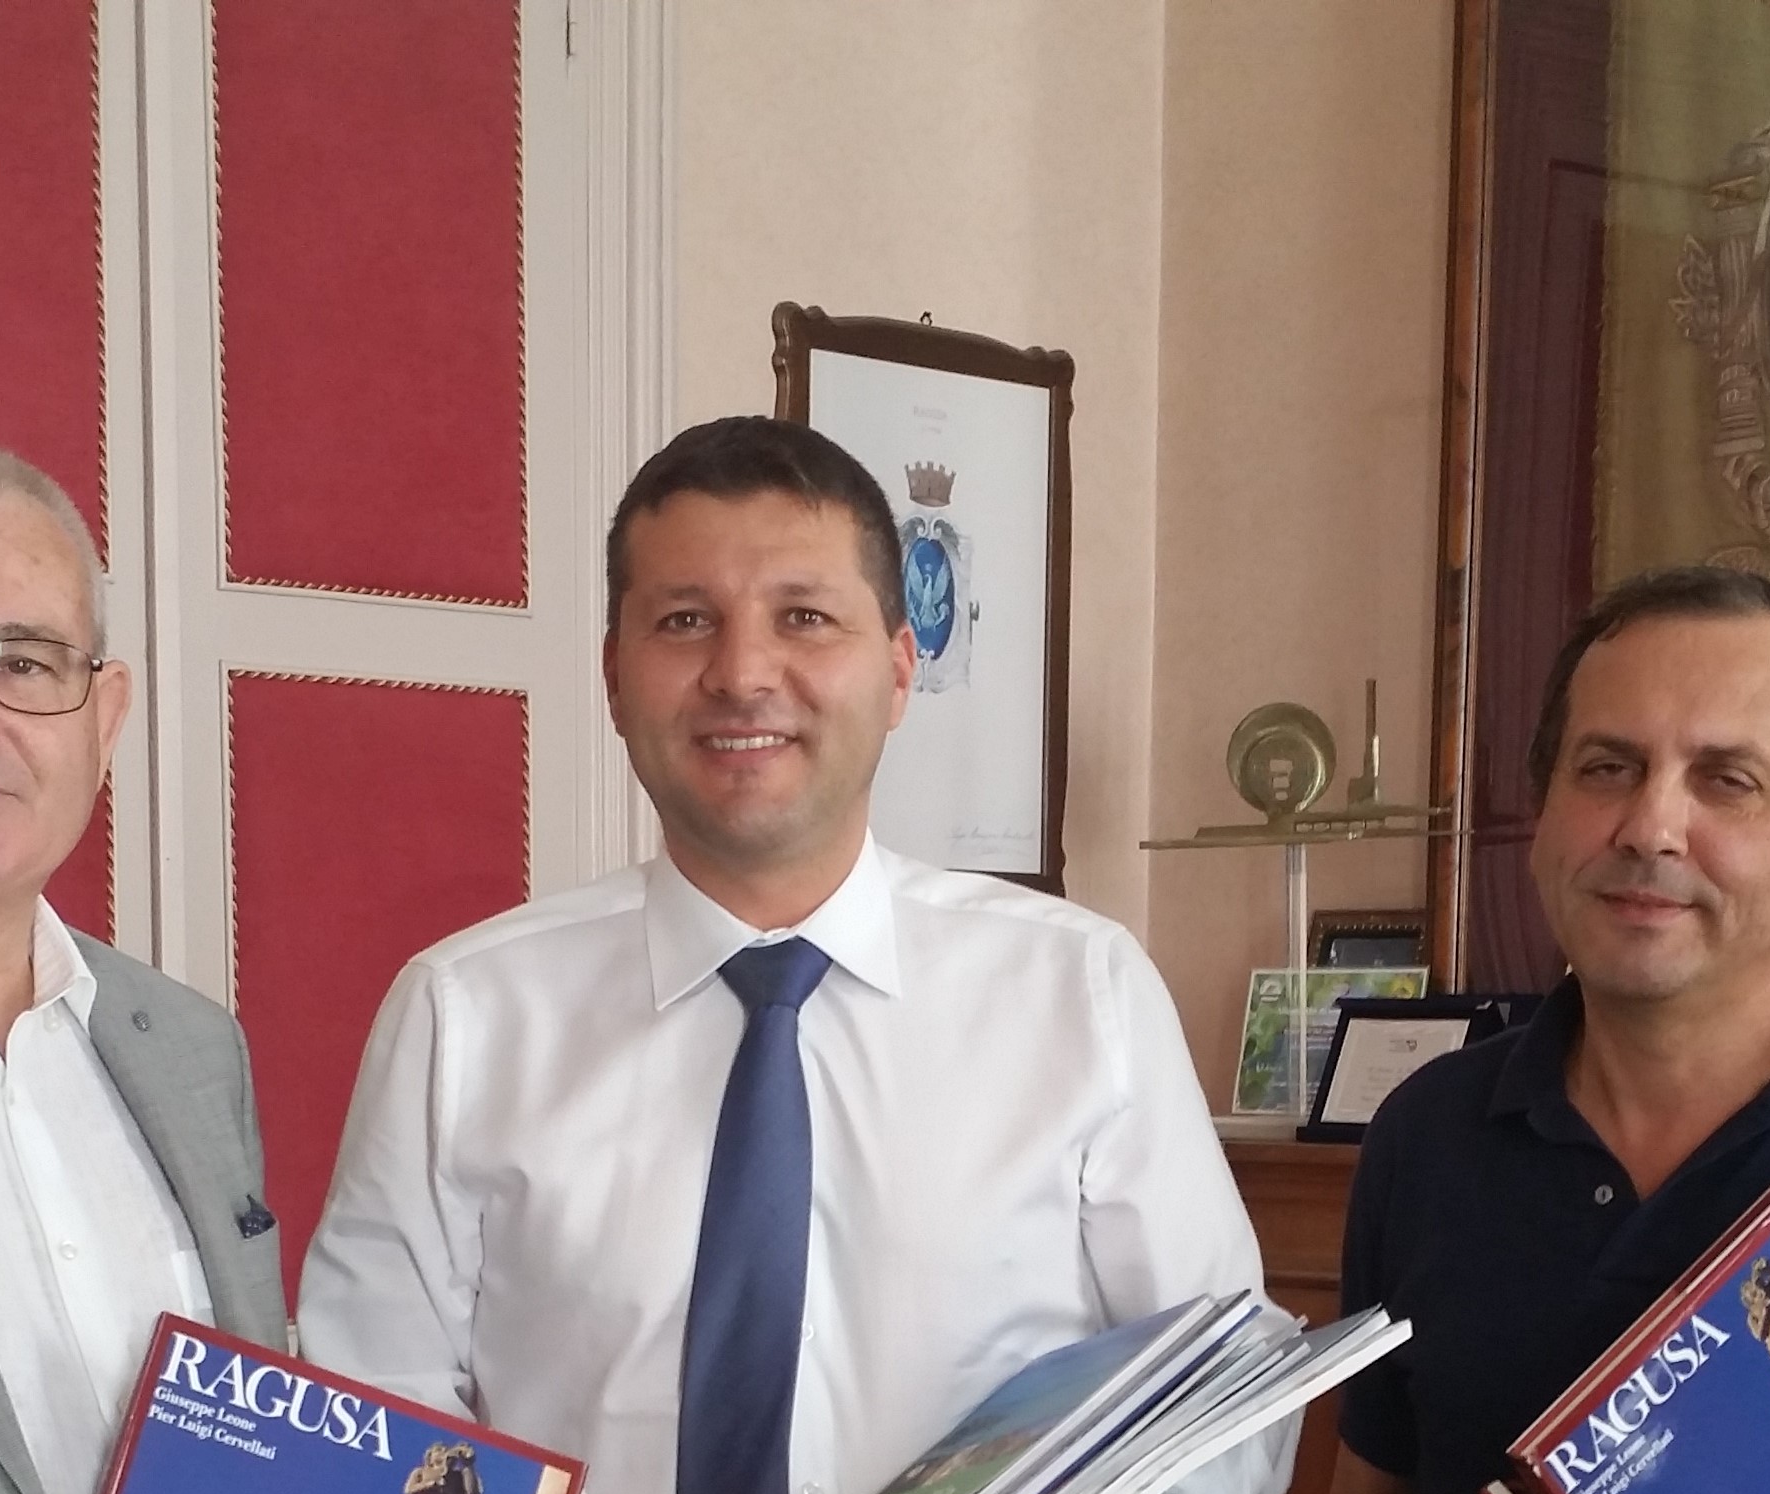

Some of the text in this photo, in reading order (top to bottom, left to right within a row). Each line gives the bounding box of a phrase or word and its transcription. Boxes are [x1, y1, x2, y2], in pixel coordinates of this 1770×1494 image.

[147, 1403, 278, 1461] Pier Luigi Cervellati
[153, 1384, 257, 1433] Giuseppe Leone
[159, 1331, 393, 1461] RAGUSA
[1543, 1314, 1731, 1494] RAGUSA
